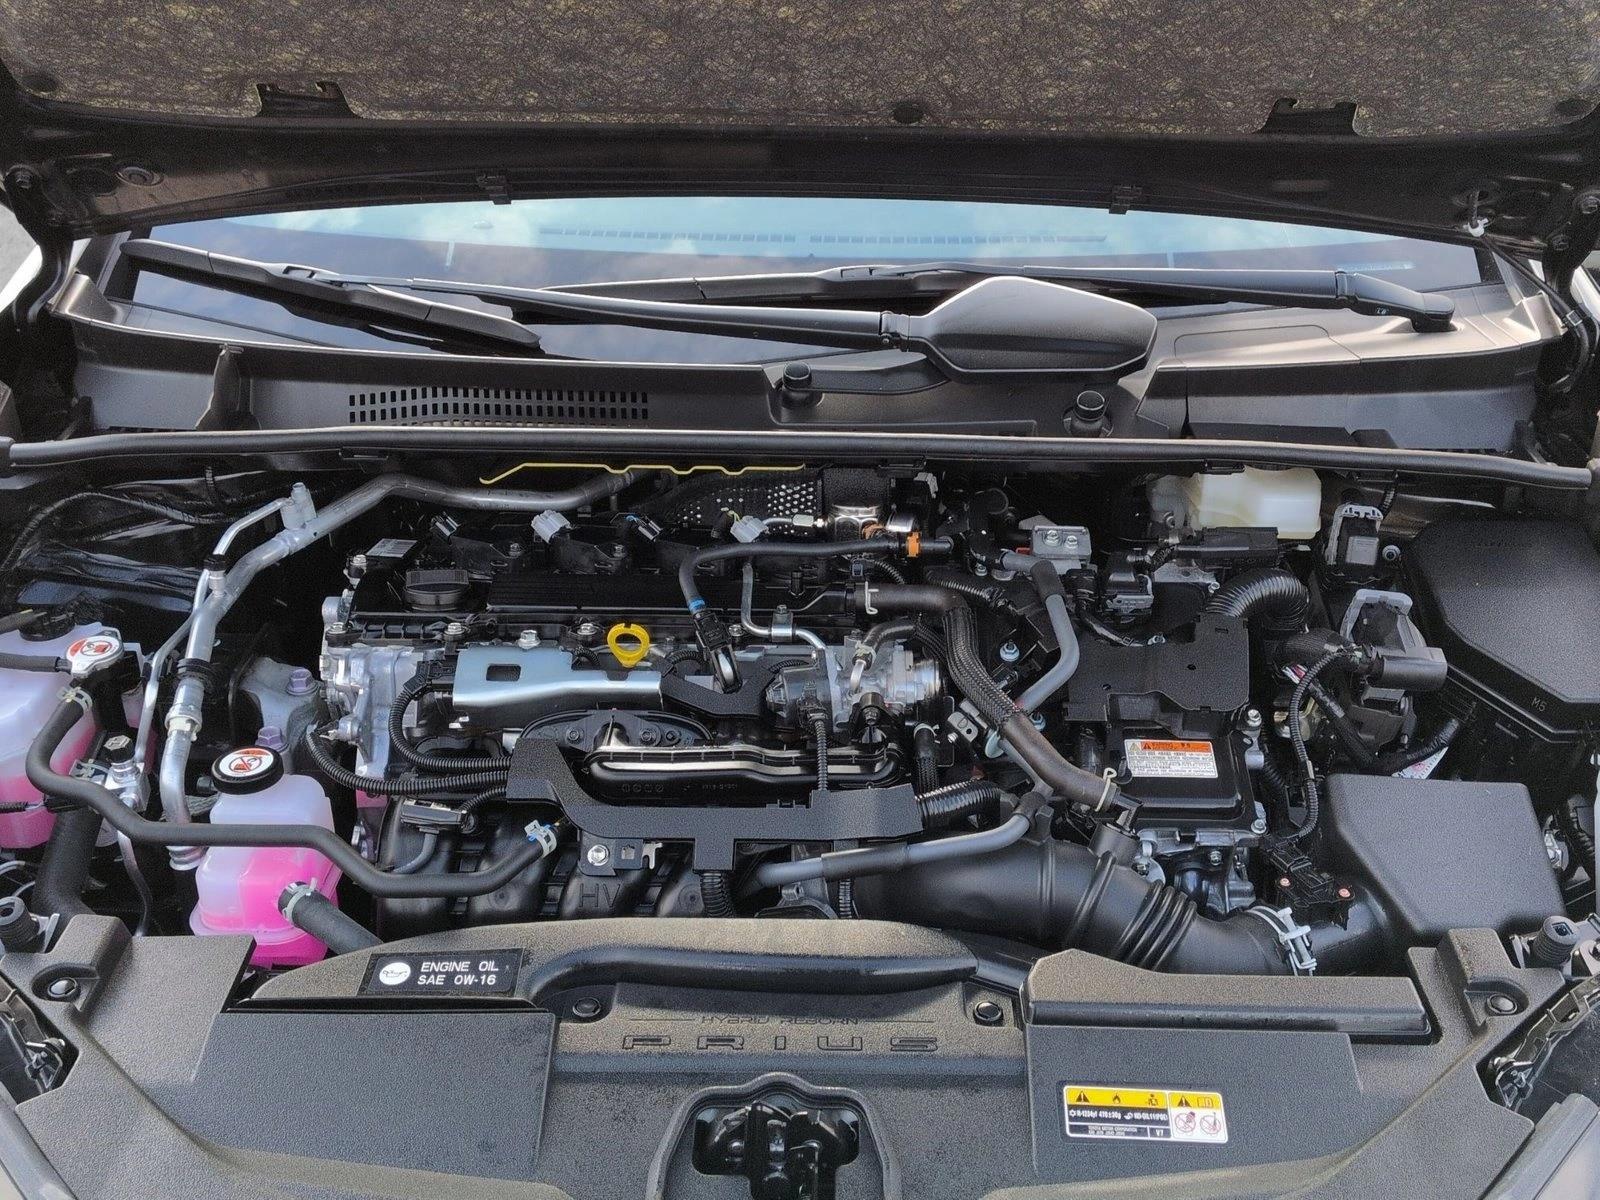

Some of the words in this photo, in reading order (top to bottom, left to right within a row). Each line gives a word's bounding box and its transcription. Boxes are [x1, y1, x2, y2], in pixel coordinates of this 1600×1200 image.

[579, 882, 621, 908] HV
[420, 961, 471, 972] ENGINE
[478, 960, 499, 972] OIL
[417, 974, 446, 986] SAE
[622, 1034, 939, 1052] PRIUS
